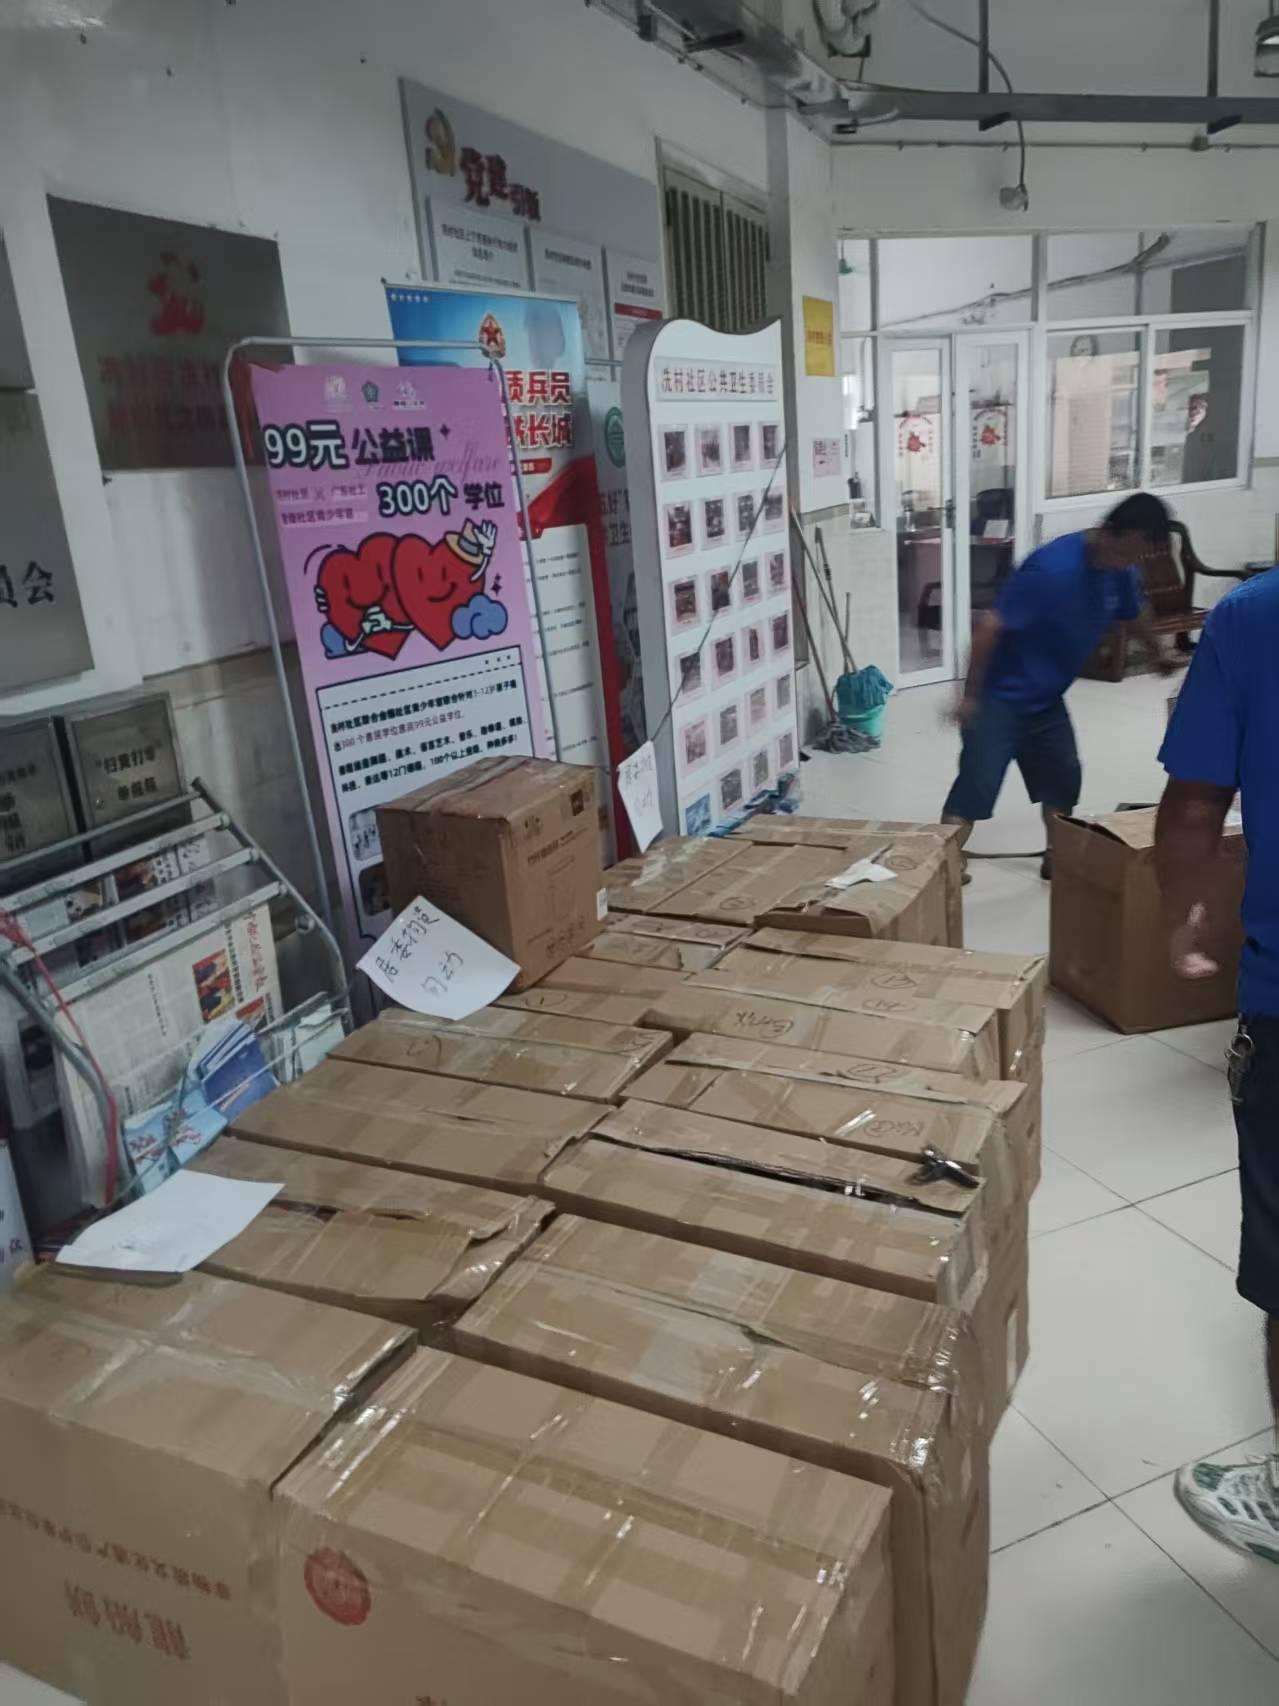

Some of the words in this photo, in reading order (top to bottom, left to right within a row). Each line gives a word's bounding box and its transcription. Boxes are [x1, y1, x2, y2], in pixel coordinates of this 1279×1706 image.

[264, 418, 350, 471] 99元
[352, 427, 435, 465] 公益课
[375, 474, 459, 517] 300个
[463, 481, 505, 510] 学位
